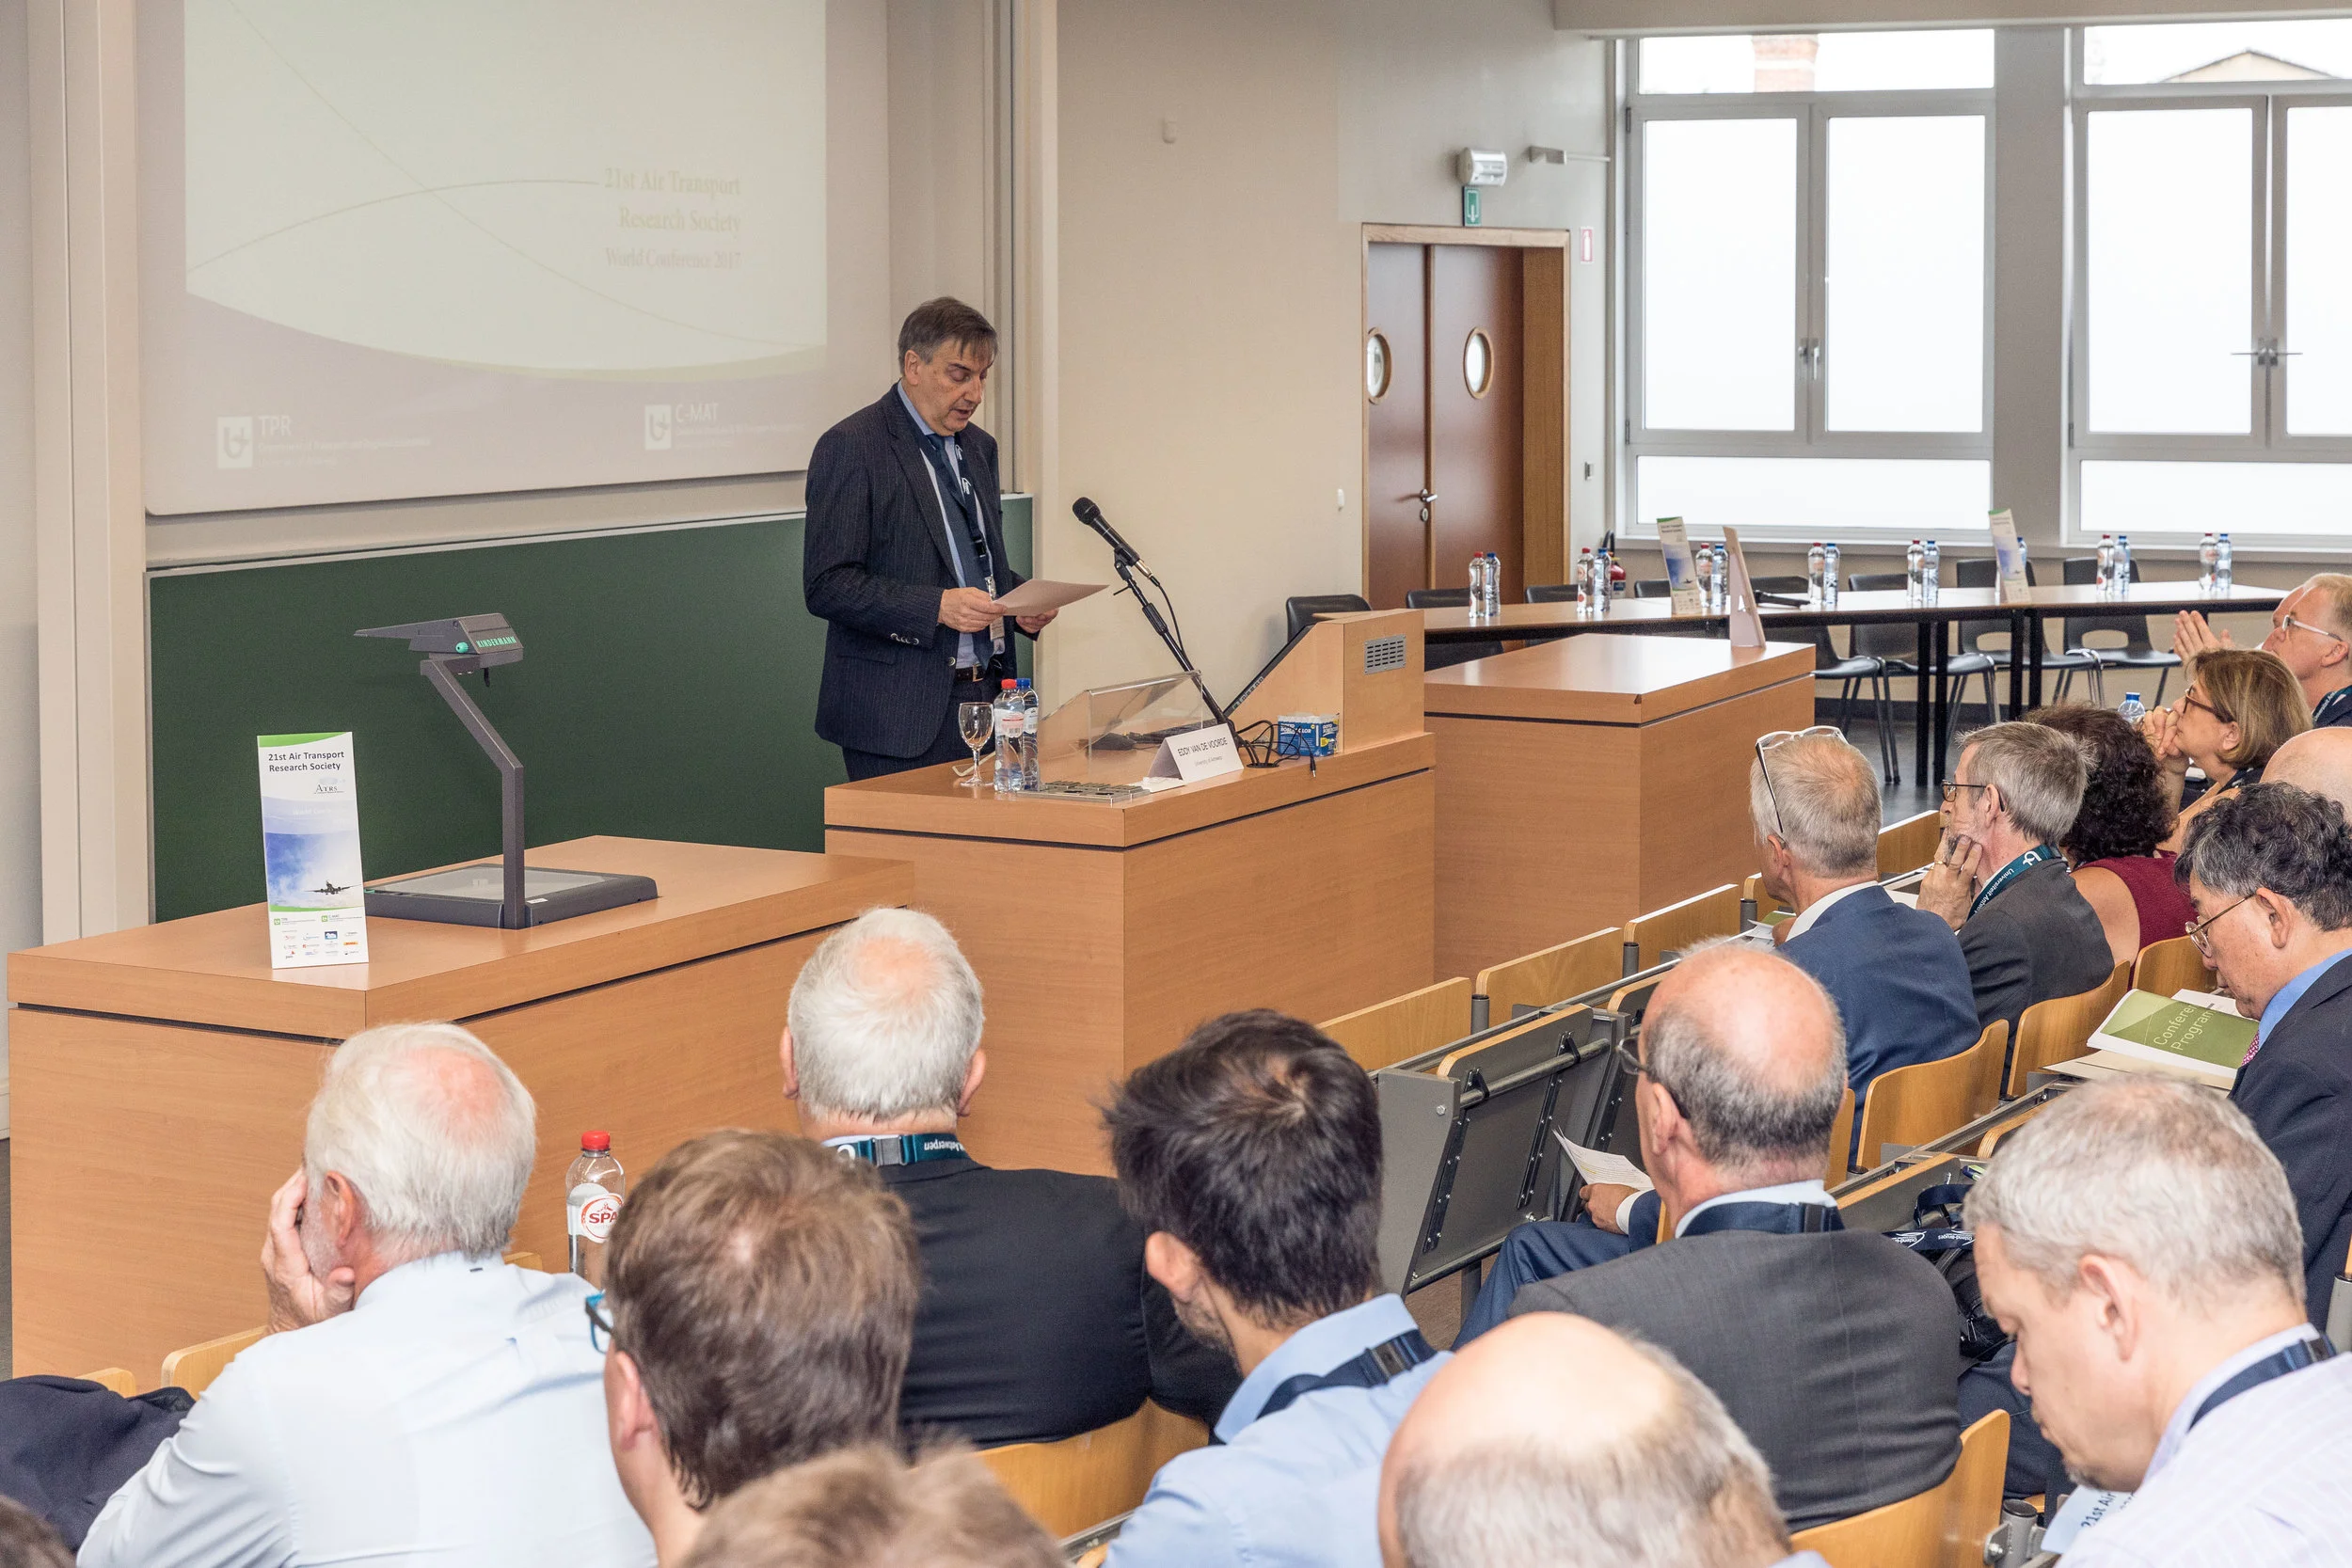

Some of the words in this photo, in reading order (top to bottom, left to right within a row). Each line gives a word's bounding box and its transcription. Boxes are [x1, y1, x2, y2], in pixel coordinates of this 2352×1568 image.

[605, 166, 636, 189] 21st
[640, 169, 665, 192] Air
[668, 170, 741, 199] Transport
[618, 205, 685, 229] Research
[690, 210, 741, 239] Society
[605, 246, 644, 268] World
[646, 247, 712, 269] Conference
[714, 250, 741, 270] 2017
[675, 402, 720, 423] C-MAT
[258, 415, 294, 436] TPR
[476, 636, 516, 648] KINDERMANN
[304, 752, 344, 760] Transport
[1178, 747, 1190, 756] EDDY
[1190, 744, 1201, 752] VAN
[1200, 742, 1209, 751] DE
[1207, 736, 1228, 748] VOORDE
[269, 764, 308, 772] Research
[310, 762, 341, 770] Society
[1987, 868, 2014, 896] Universiteit
[589, 1212, 618, 1223] SPA
